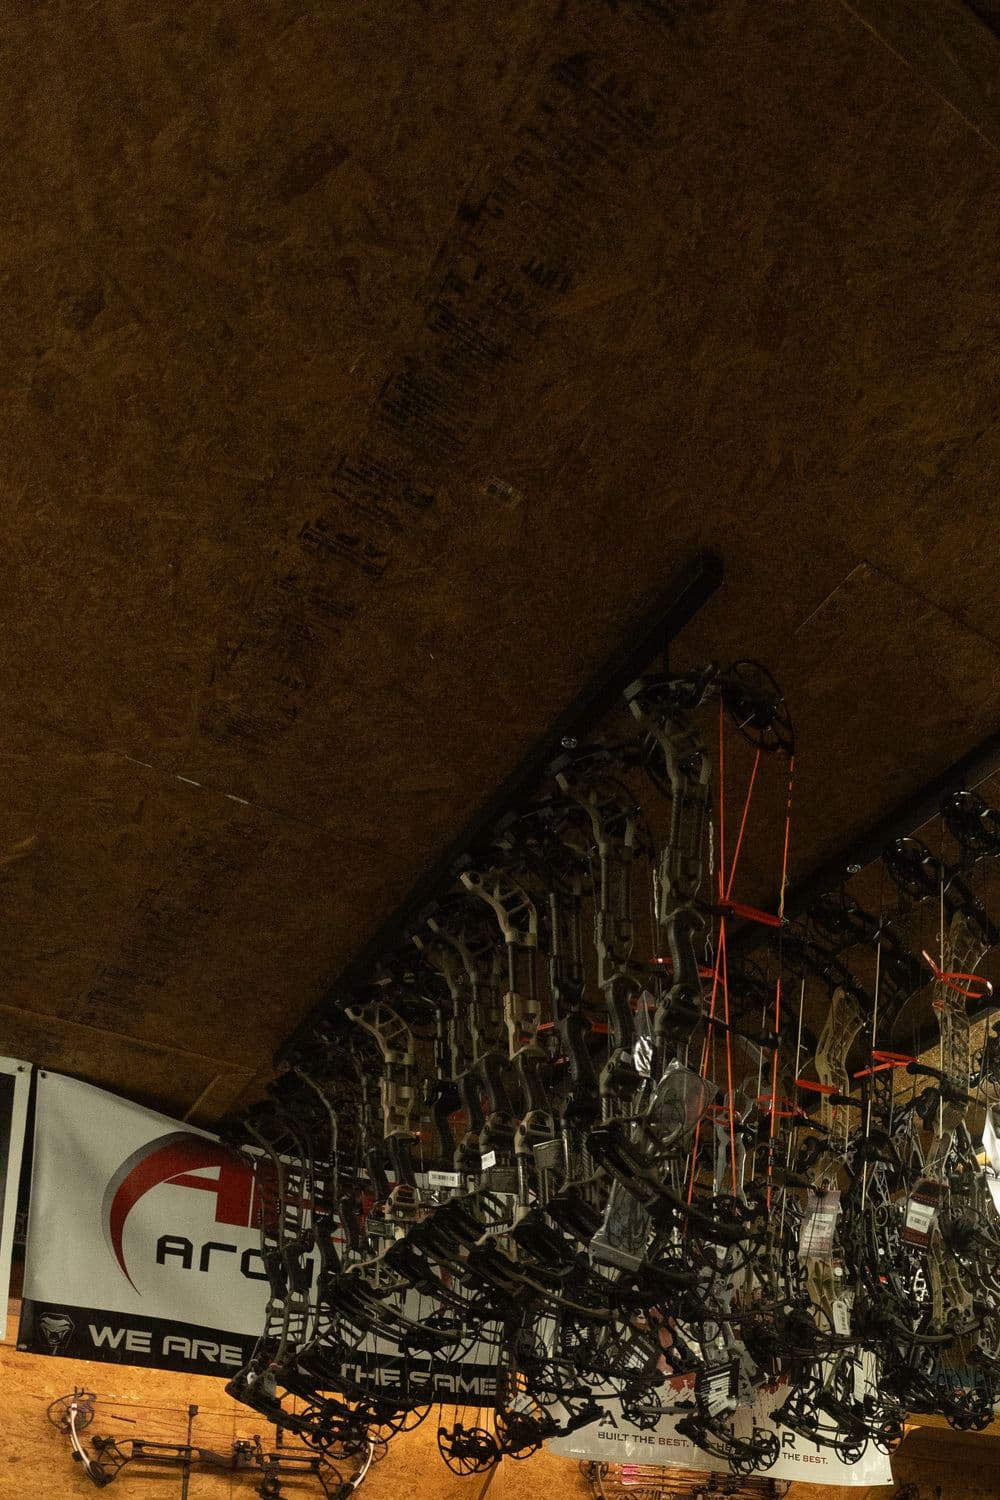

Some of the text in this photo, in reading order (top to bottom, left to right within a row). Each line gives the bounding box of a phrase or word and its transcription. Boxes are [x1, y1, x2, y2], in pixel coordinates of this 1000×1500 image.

[88, 1324, 152, 1353] WE
[162, 1335, 243, 1366] ARE
[598, 1431, 630, 1442] BUILT
[632, 1434, 656, 1445] THE
[658, 1437, 690, 1448] BEST.
[782, 1451, 829, 1465] THE BEST.
